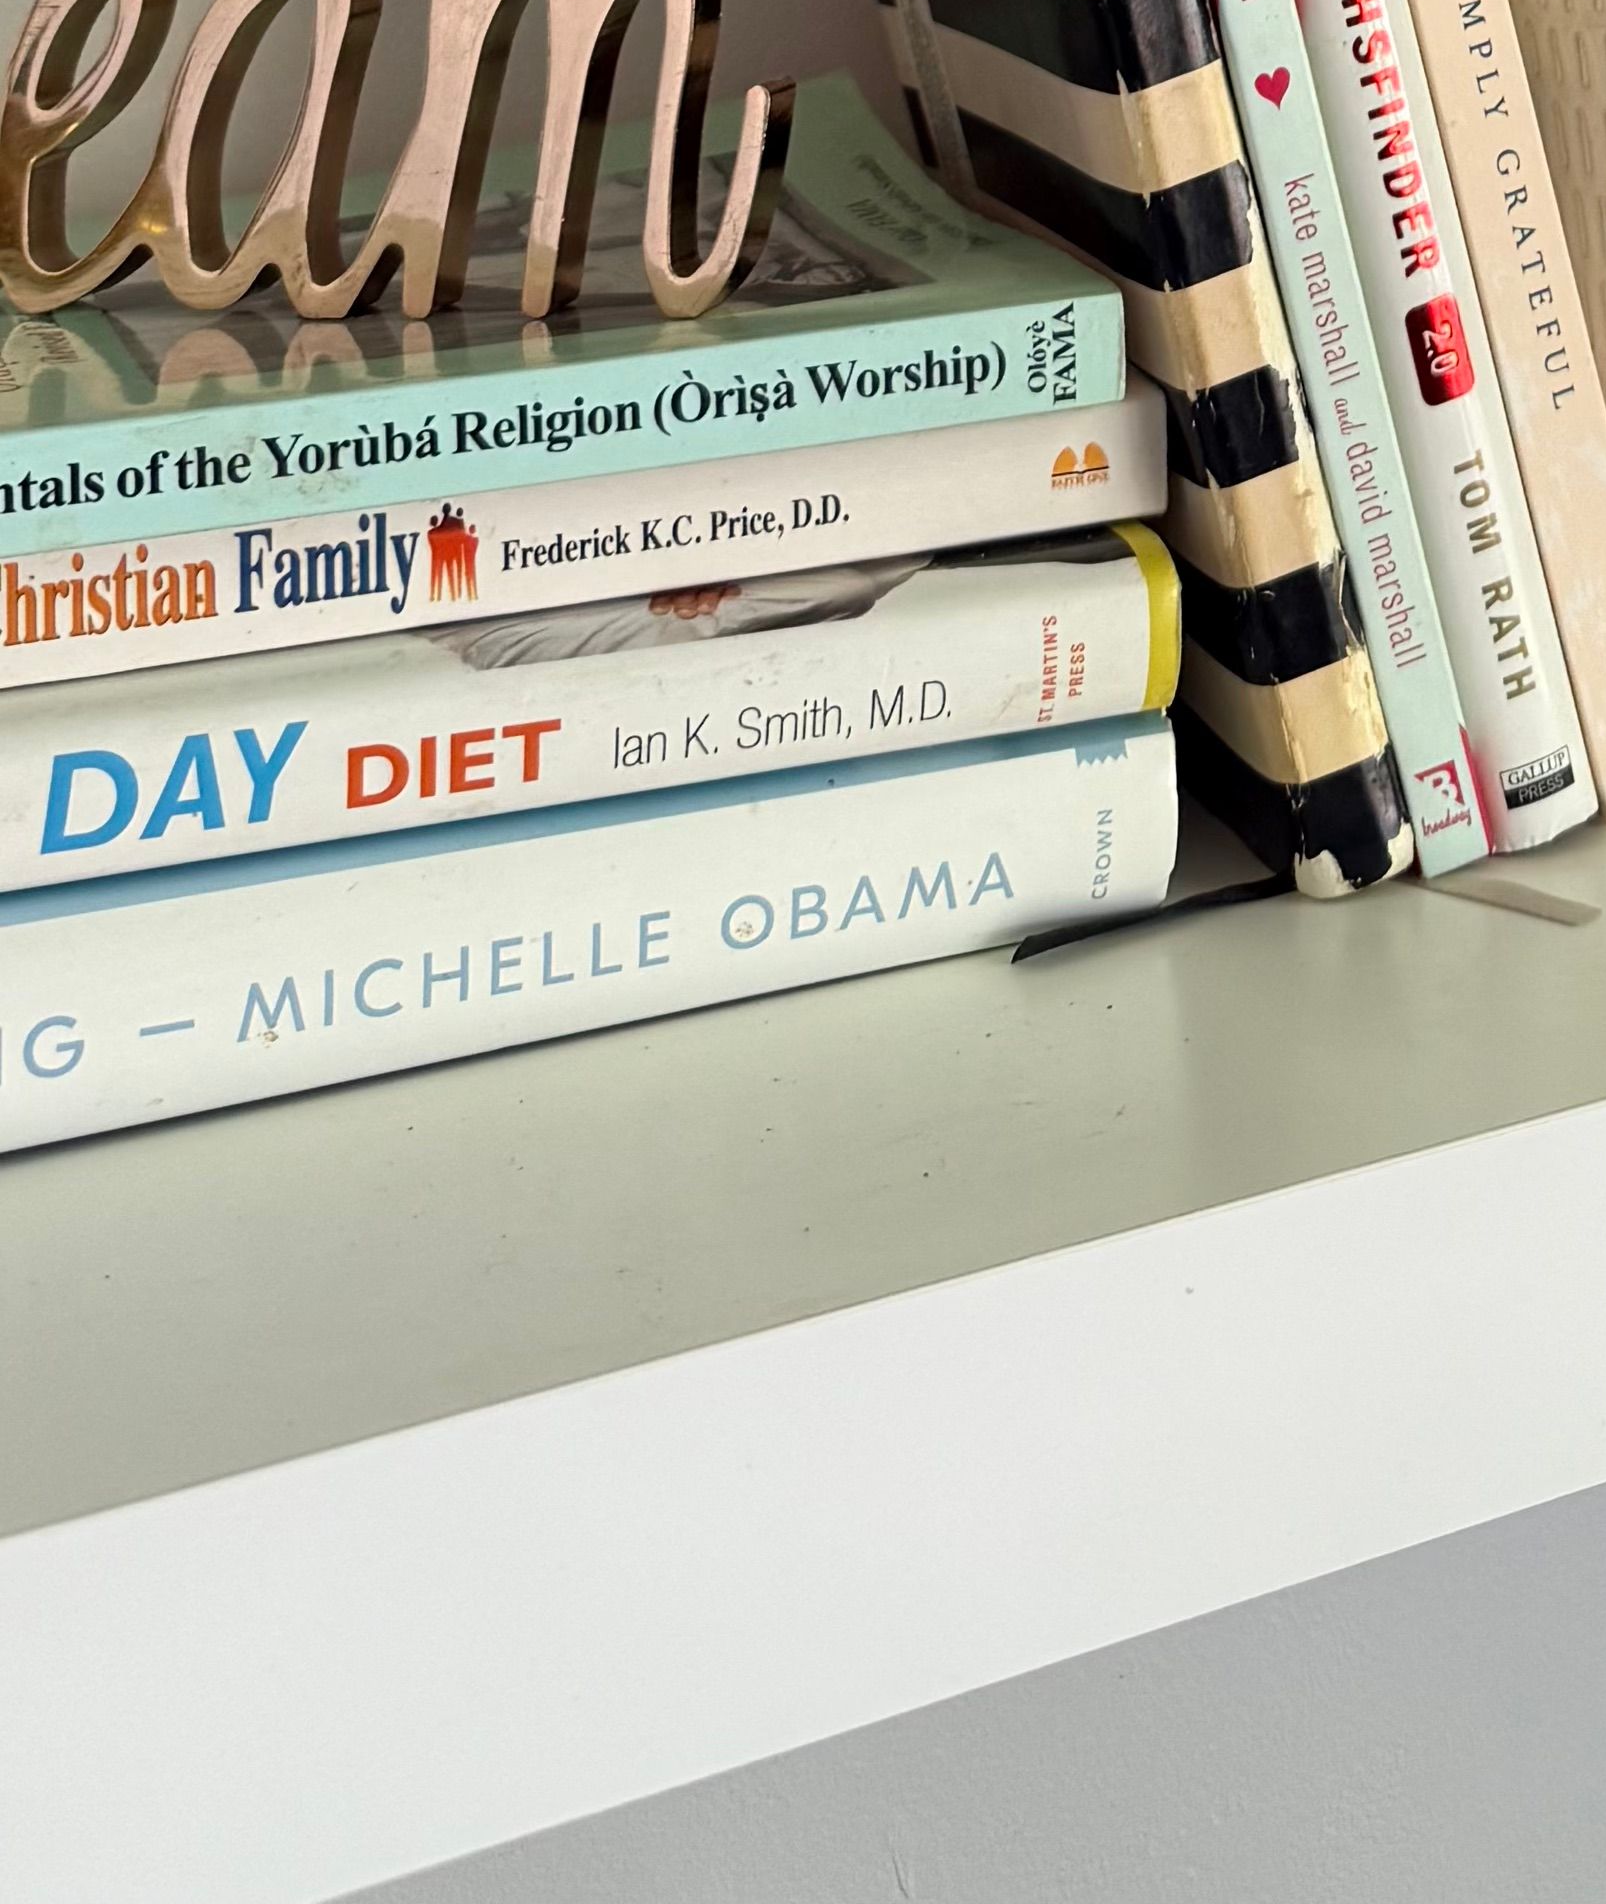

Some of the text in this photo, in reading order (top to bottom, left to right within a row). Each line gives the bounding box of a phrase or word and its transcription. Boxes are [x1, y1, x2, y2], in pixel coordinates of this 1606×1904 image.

[1496, 147, 1581, 411] GRATEFUL
[117, 450, 170, 496] of
[175, 446, 252, 492] the
[262, 415, 441, 479] Yorùbá
[452, 395, 642, 455] Religion
[805, 341, 1006, 406] Worship)
[1026, 320, 1051, 393] Olóyè
[1052, 301, 1077, 406] FAMA
[1284, 172, 1427, 669] kate marshall and david marshall
[0, 493, 850, 648] hristian Family Frederick K.C. Price, D.D.
[1422, 318, 1460, 378] 2.0
[1453, 448, 1502, 554] TOM
[1481, 575, 1537, 701] RATH
[1041, 615, 1058, 700] MARTIN'S
[1068, 641, 1086, 698] PRESS
[41, 680, 952, 854] DAY DIET Ian K. Smith, M.D.
[1508, 752, 1566, 787] GALLUP
[1518, 772, 1565, 803] PRESS
[1091, 808, 1114, 900] CROWN
[0, 1015, 84, 1086] G
[237, 909, 671, 1044] MICHELLE
[720, 850, 1015, 950] OBAMA
